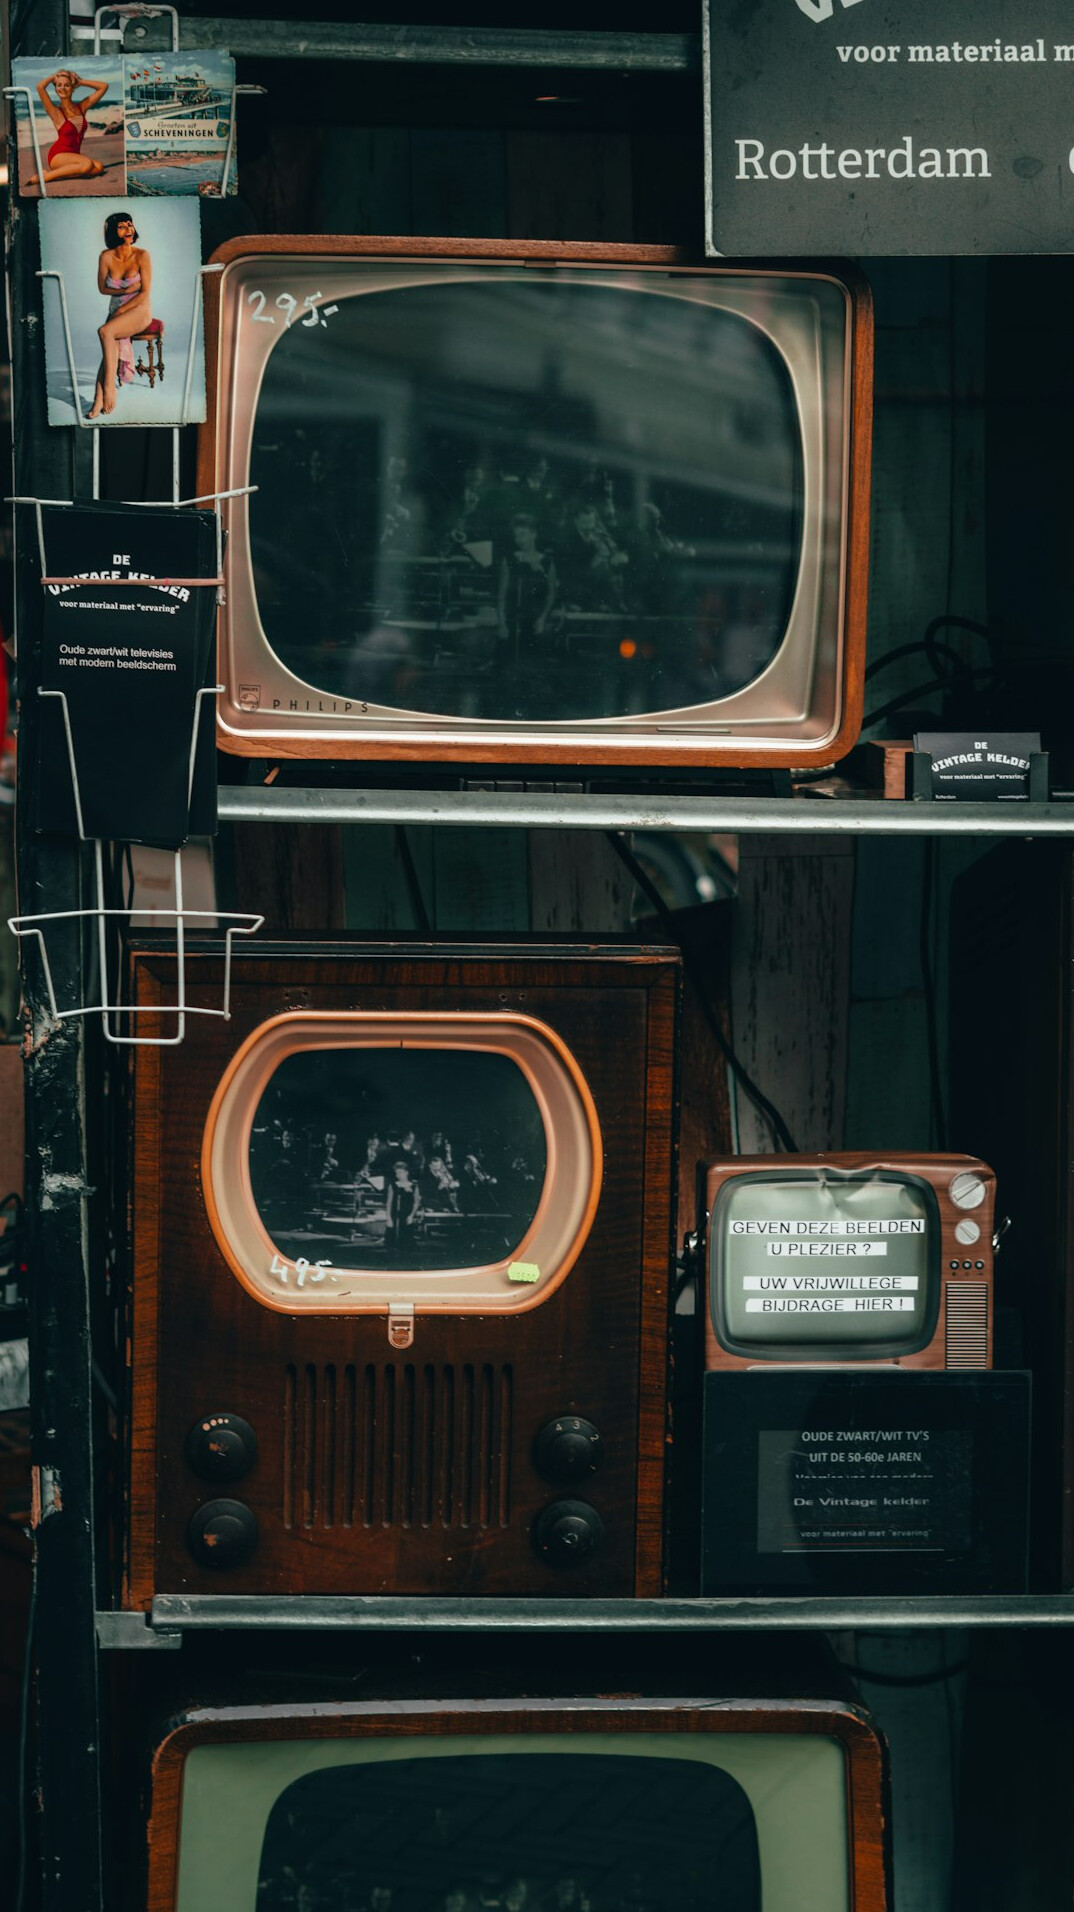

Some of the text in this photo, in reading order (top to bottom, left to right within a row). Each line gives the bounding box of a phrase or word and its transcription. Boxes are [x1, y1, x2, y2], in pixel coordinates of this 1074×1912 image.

[836, 45, 900, 63] voor
[907, 38, 1047, 63] materiaal
[143, 129, 214, 137] SCHEVENINGEN
[734, 136, 992, 180] Rotterdam
[112, 554, 131, 566] DE
[59, 600, 78, 608] voor
[79, 601, 118, 610] materiaal
[119, 603, 136, 611] met
[59, 643, 174, 659] Oude zwart/wit televisies
[59, 657, 177, 671] met modern beeldscherm
[273, 699, 368, 713] PHILIPS
[974, 741, 988, 750] DE
[931, 753, 983, 773] VINTAGE
[733, 1220, 921, 1235] GEVEN DEZE BEELDEN
[771, 1243, 783, 1255] U
[788, 1243, 857, 1255] PLEZIER
[760, 1277, 902, 1290] UW VRIJWILLEGE
[762, 1299, 844, 1312] BIJDRAGE
[855, 1298, 893, 1310] HIER
[801, 1430, 930, 1443] OUDE ZWART/WIT TV'S
[809, 1452, 922, 1462] UIT DE 50-60e JAREN
[793, 1497, 930, 1507] De Vintage kelder
